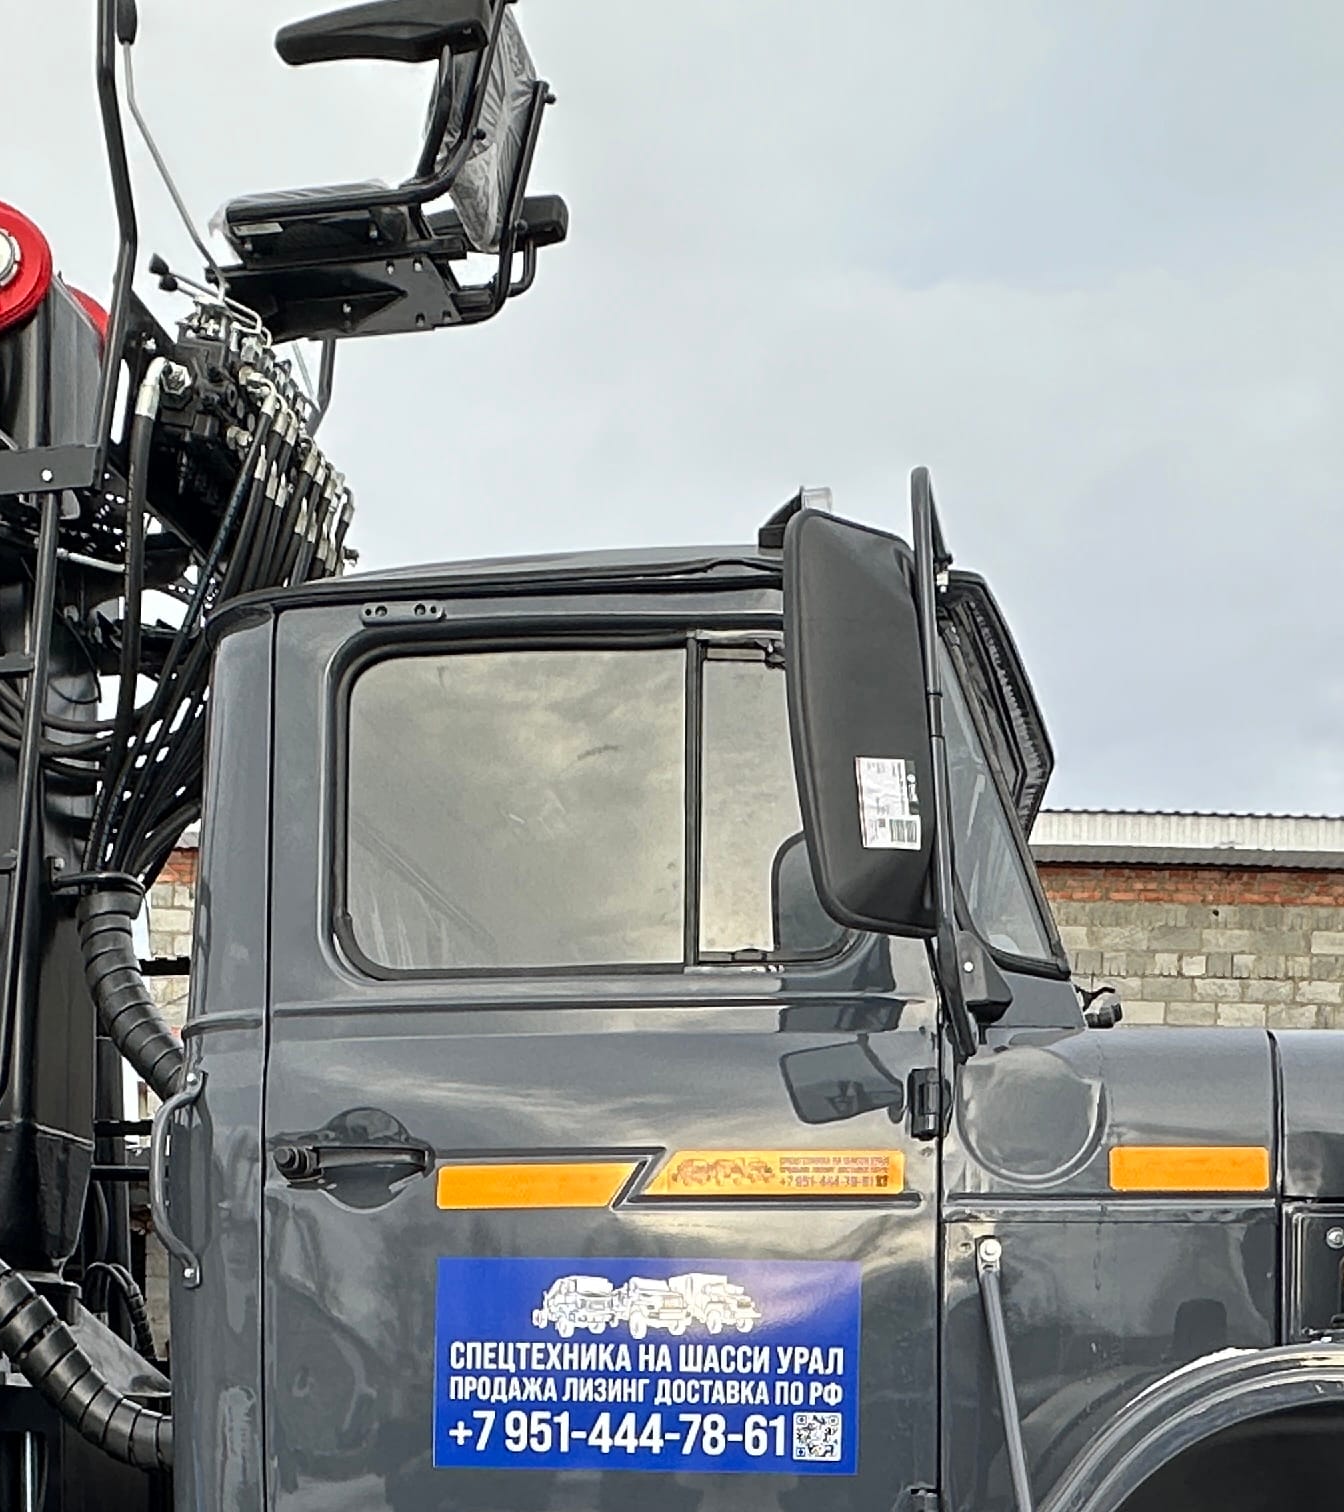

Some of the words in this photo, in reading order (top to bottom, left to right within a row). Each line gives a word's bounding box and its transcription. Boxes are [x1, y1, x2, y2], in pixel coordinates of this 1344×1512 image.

[449, 1341, 632, 1373] СПЕЦТЕХНИКА
[639, 1343, 672, 1372] НА
[679, 1344, 770, 1375] ШАССИ
[776, 1346, 844, 1376] УРАЛ
[449, 1375, 557, 1403] ПРОДАЖА
[562, 1377, 650, 1403] ЛИЗИНГ
[653, 1379, 770, 1406] ДОСТАВКА
[775, 1381, 804, 1406] ПО
[808, 1381, 843, 1406] РФ
[448, 1410, 496, 1451] +7
[504, 1410, 786, 1456] 951-444-78-61
